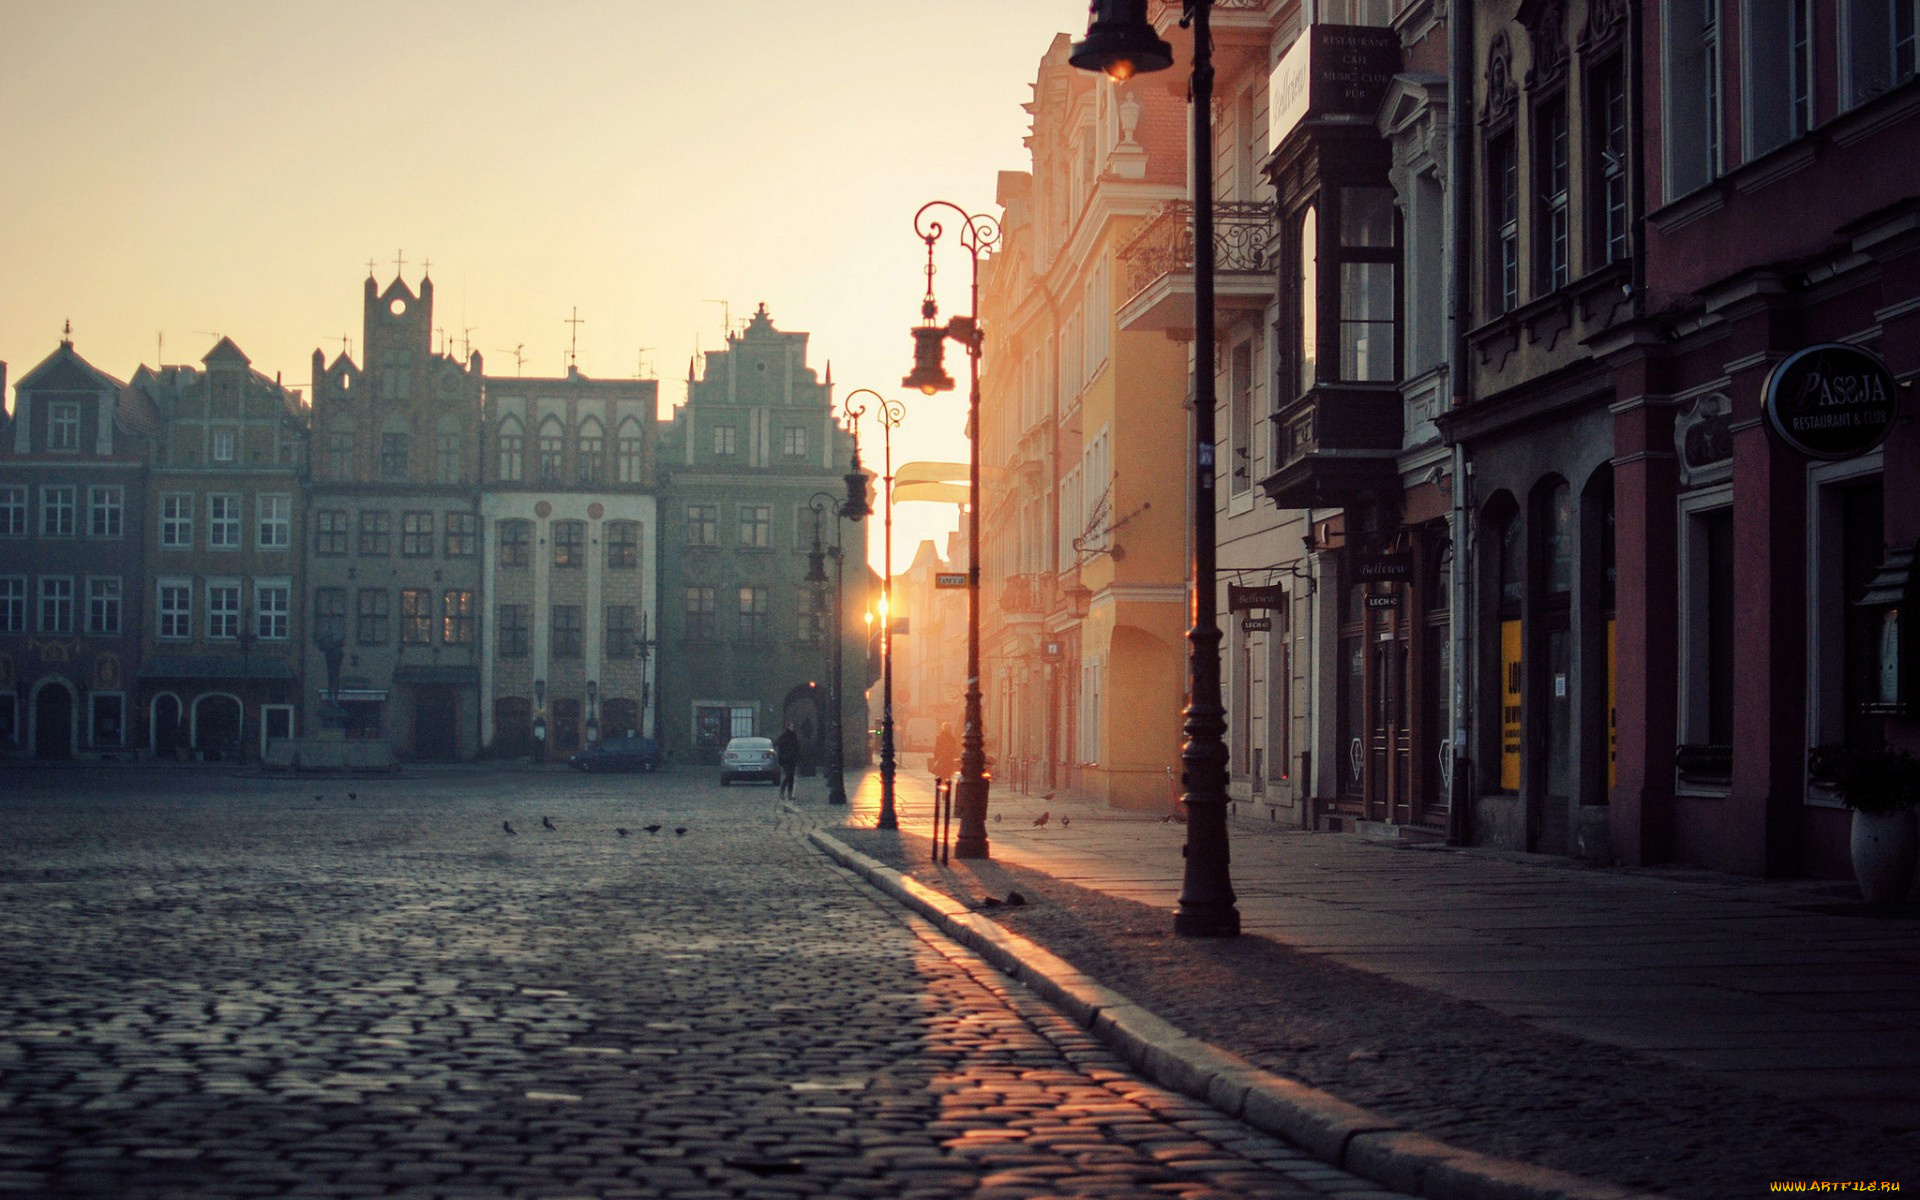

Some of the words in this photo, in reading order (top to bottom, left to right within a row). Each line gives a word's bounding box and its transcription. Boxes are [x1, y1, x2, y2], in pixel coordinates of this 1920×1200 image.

[1322, 35, 1389, 48] RESTAURANT
[1323, 72, 1353, 82] MUSIC
[1361, 74, 1388, 84] CLUB
[1345, 88, 1366, 98] PUB
[1792, 412, 1850, 431] RESTAURANT
[1853, 413, 1861, 425] &
[1864, 410, 1887, 425] CLUB
[1360, 560, 1407, 575] Bellview
[1238, 591, 1275, 603] Bellview
[1369, 596, 1389, 607] LECH
[1245, 621, 1261, 629] LECH
